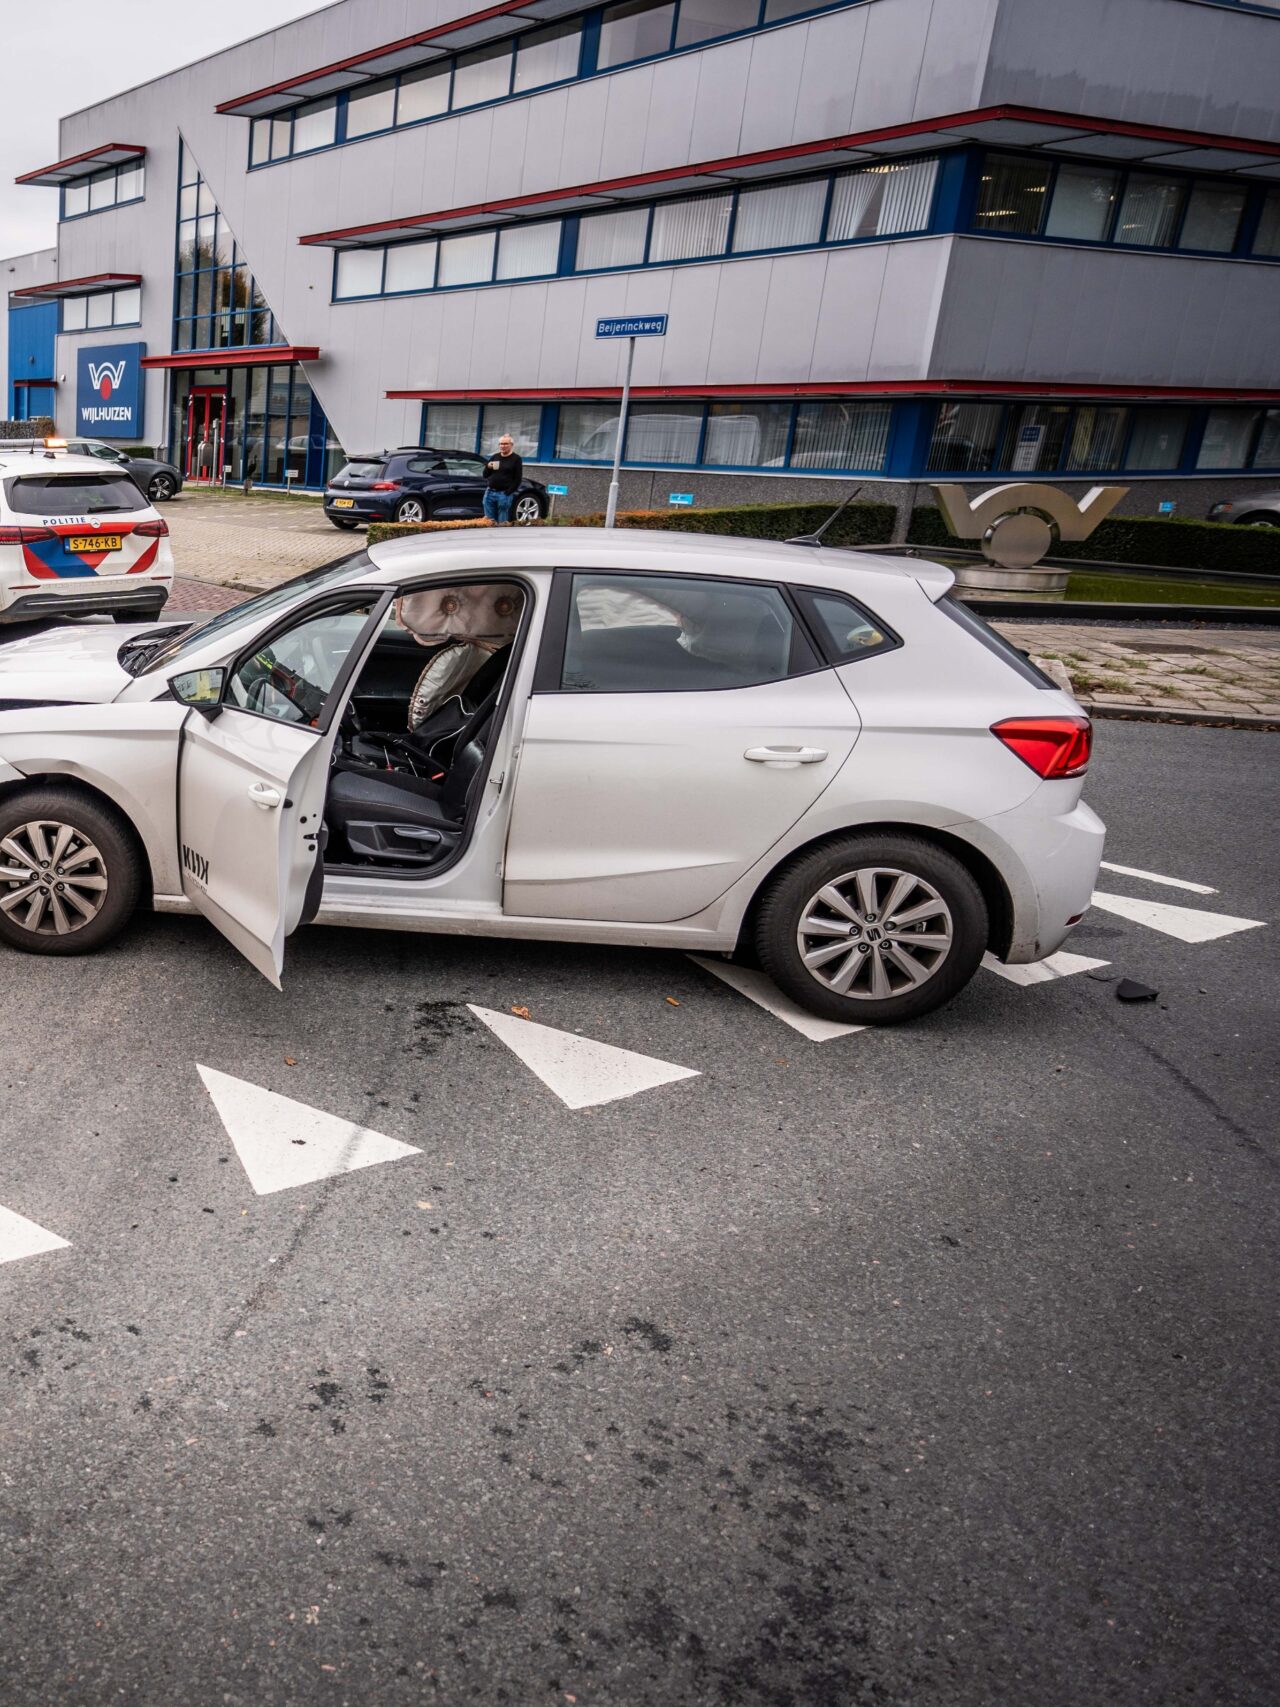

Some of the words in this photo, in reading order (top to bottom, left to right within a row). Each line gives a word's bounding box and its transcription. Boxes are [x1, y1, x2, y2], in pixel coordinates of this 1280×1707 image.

[598, 321, 662, 335] Beijerinckweg
[81, 407, 132, 424] WIJLHUIZEN
[42, 516, 86, 526] POLITIE
[72, 537, 118, 550] S-746-KB
